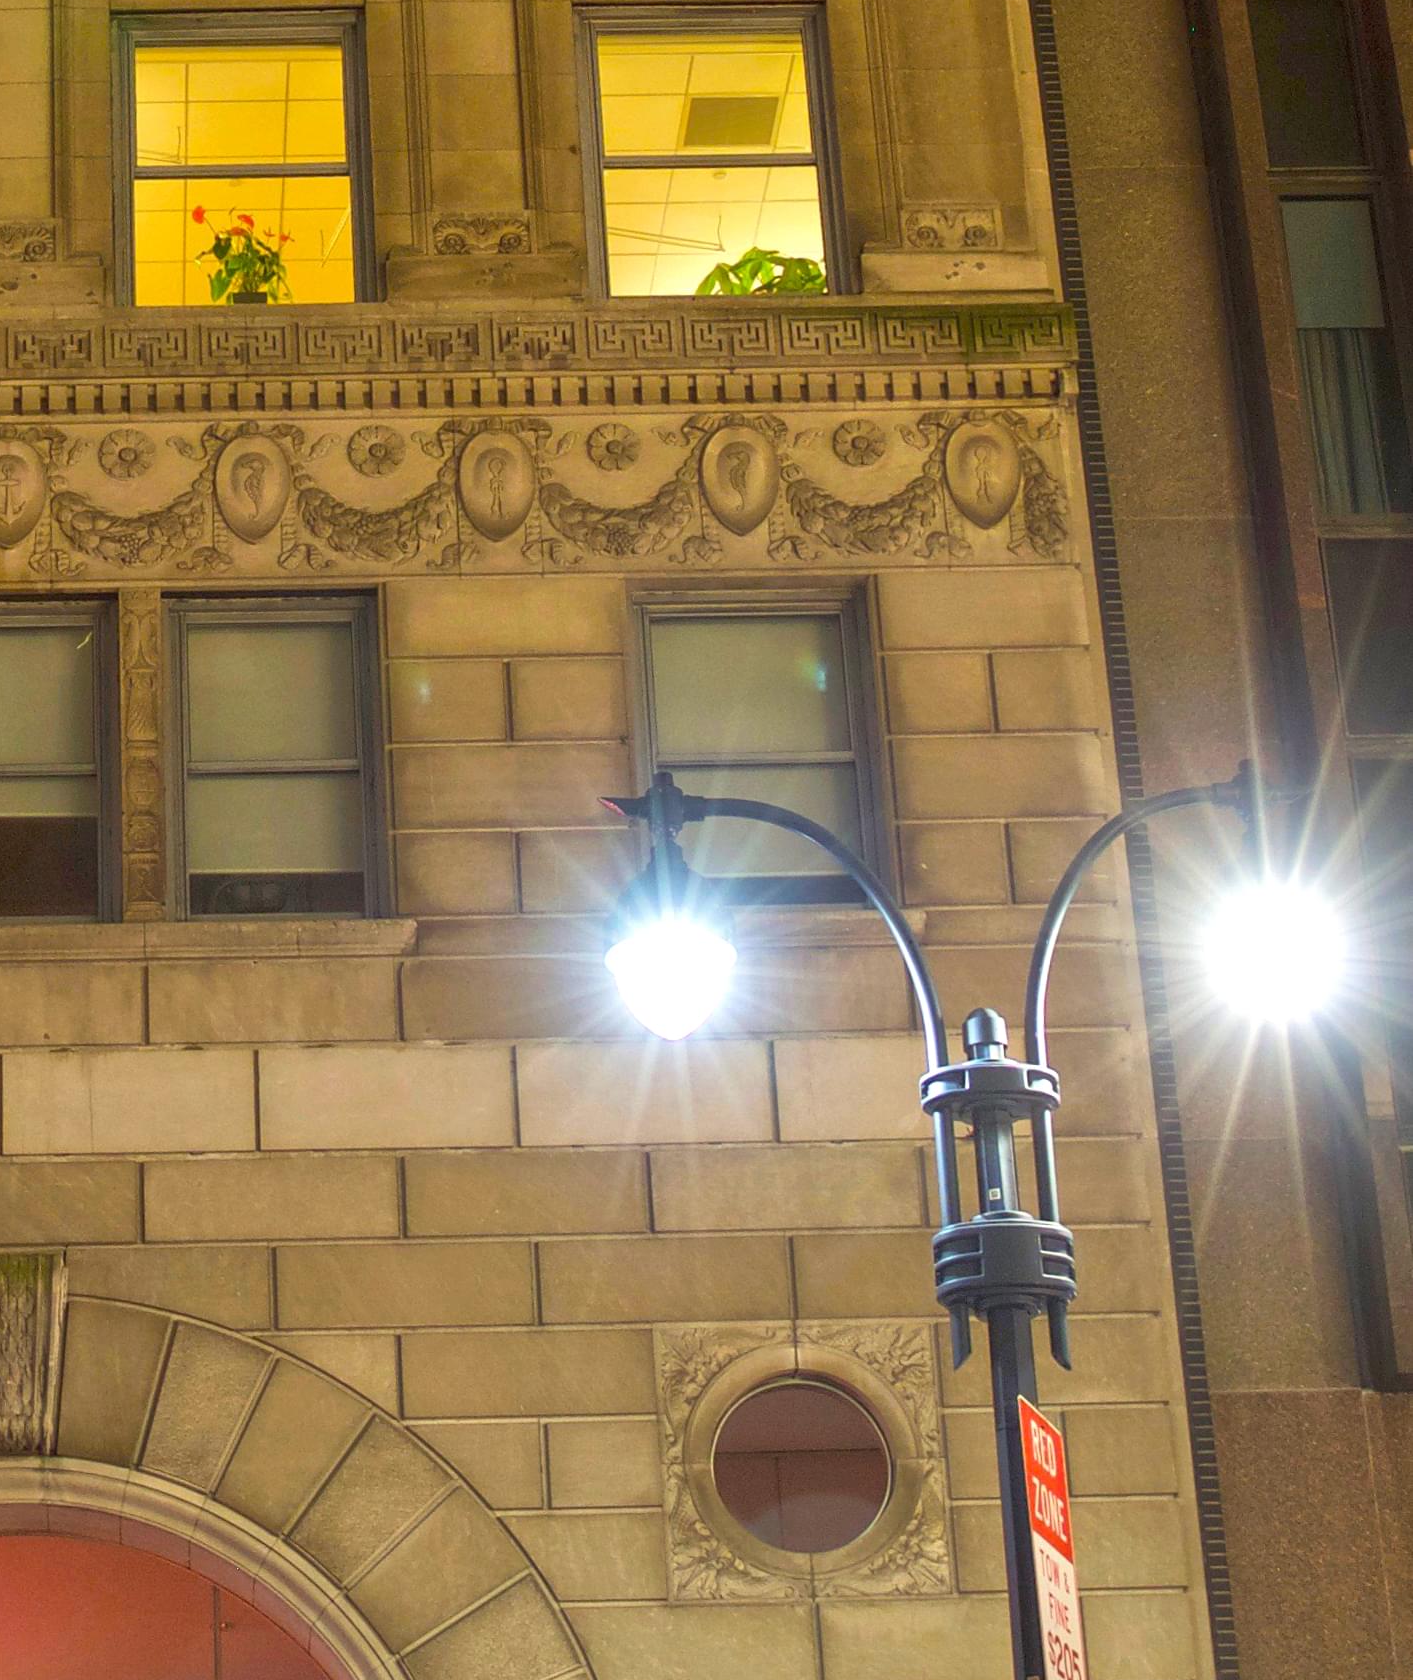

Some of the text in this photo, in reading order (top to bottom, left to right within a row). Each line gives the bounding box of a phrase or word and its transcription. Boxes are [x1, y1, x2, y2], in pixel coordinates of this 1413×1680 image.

[1030, 1419, 1058, 1478] RED
[1032, 1476, 1068, 1543] ZONE
[1039, 1548, 1071, 1594] TOW &
[1048, 1591, 1072, 1635] FINE
